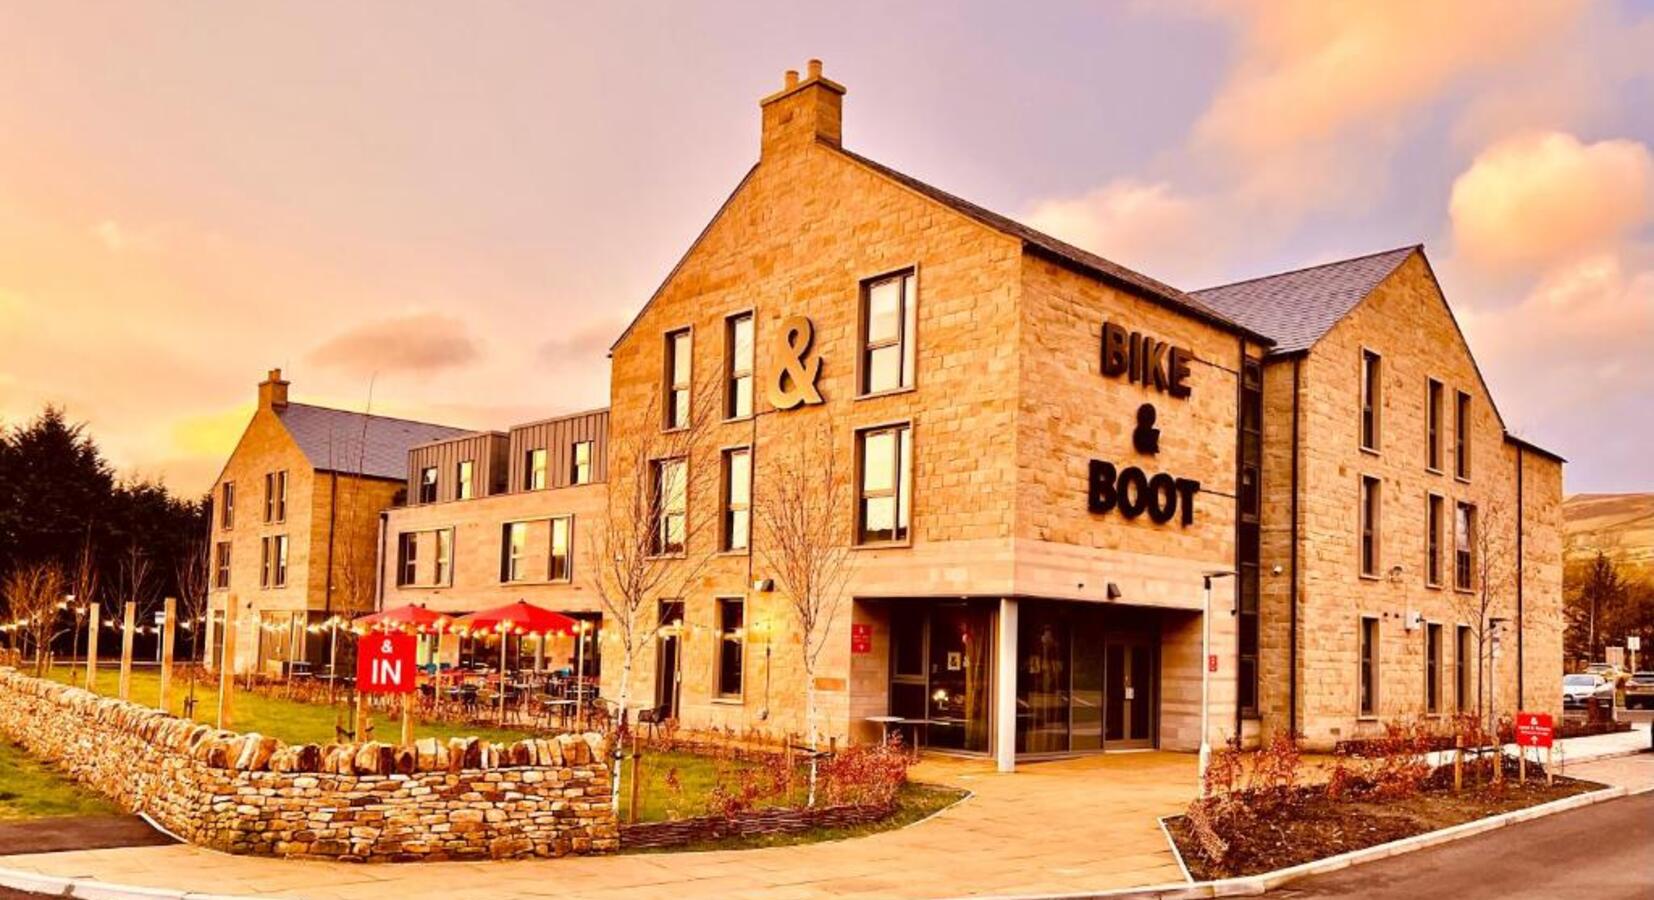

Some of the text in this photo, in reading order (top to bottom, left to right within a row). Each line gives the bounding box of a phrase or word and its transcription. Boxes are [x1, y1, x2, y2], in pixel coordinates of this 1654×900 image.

[768, 316, 825, 410] &
[1101, 321, 1193, 398] BIKE
[1133, 403, 1160, 455] &
[1088, 459, 1200, 527] BOOT
[371, 658, 401, 685] IN
[380, 639, 393, 653] &
